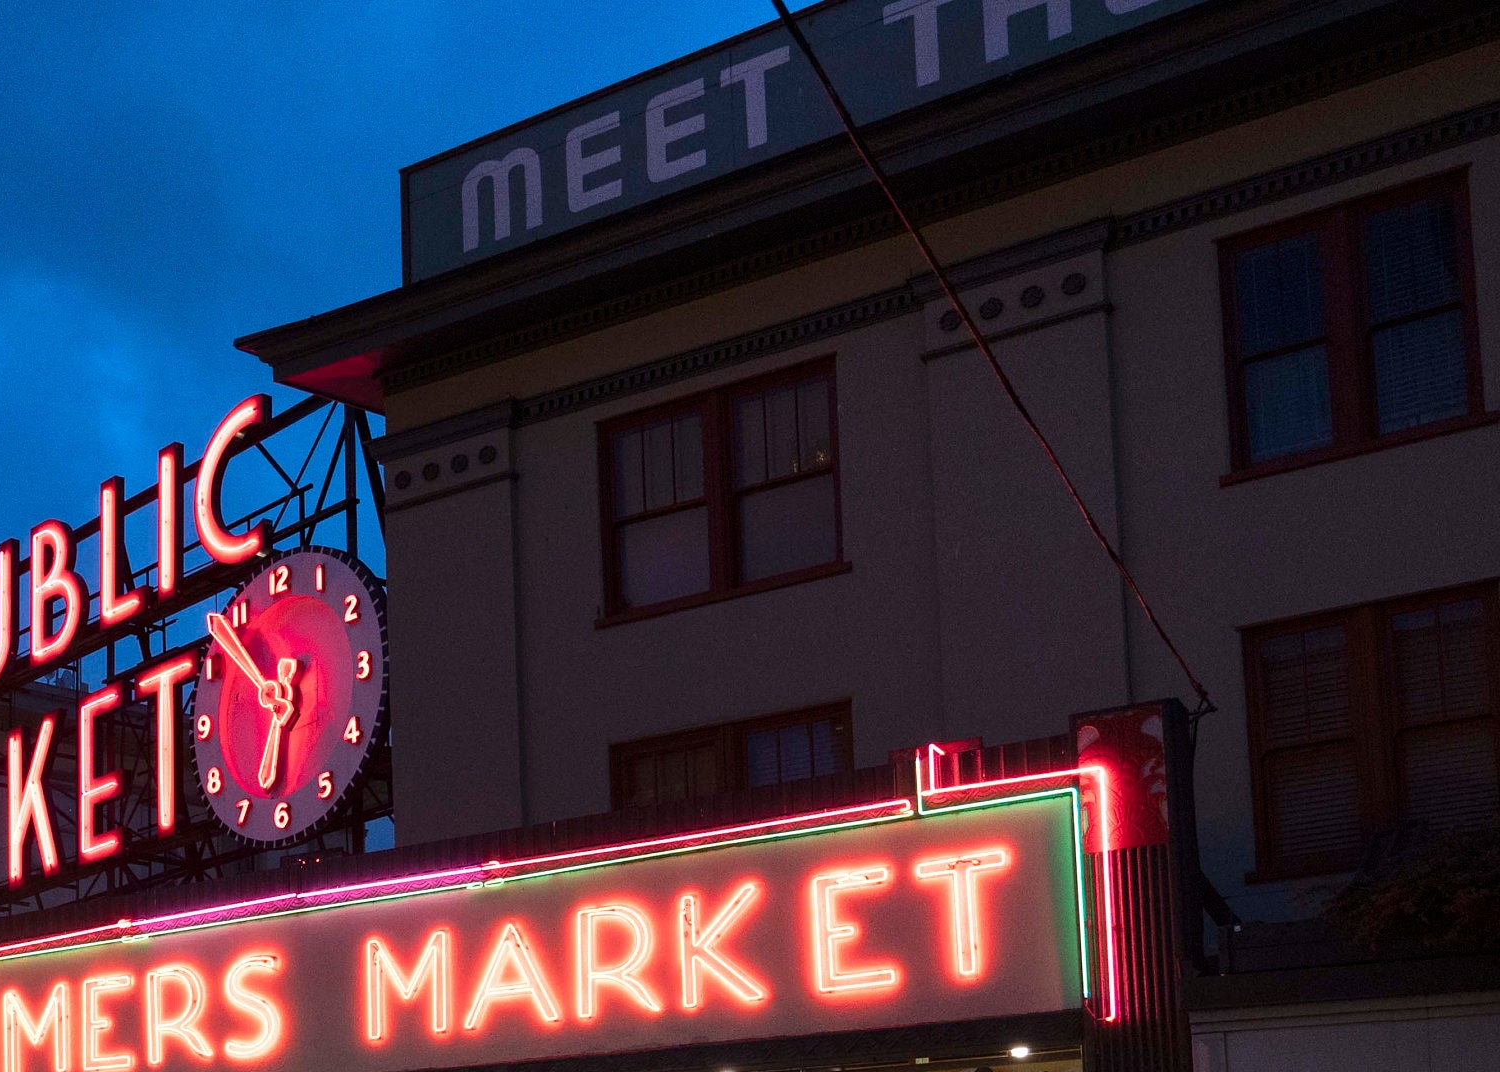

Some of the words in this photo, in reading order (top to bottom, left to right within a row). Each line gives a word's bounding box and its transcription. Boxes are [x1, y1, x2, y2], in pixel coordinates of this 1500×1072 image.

[461, 45, 791, 253] MEET
[882, 0, 1160, 88] TH
[268, 566, 291, 596] 12
[316, 565, 324, 592] 1
[233, 599, 247, 628] 11
[345, 595, 361, 623] 2
[356, 651, 372, 680] 3
[198, 714, 214, 741] 9
[344, 717, 362, 743] 4
[207, 767, 223, 794] 8
[318, 771, 333, 798] 5
[237, 799, 253, 825] 7
[274, 802, 291, 829] 6
[366, 847, 1009, 1041] MARKET
